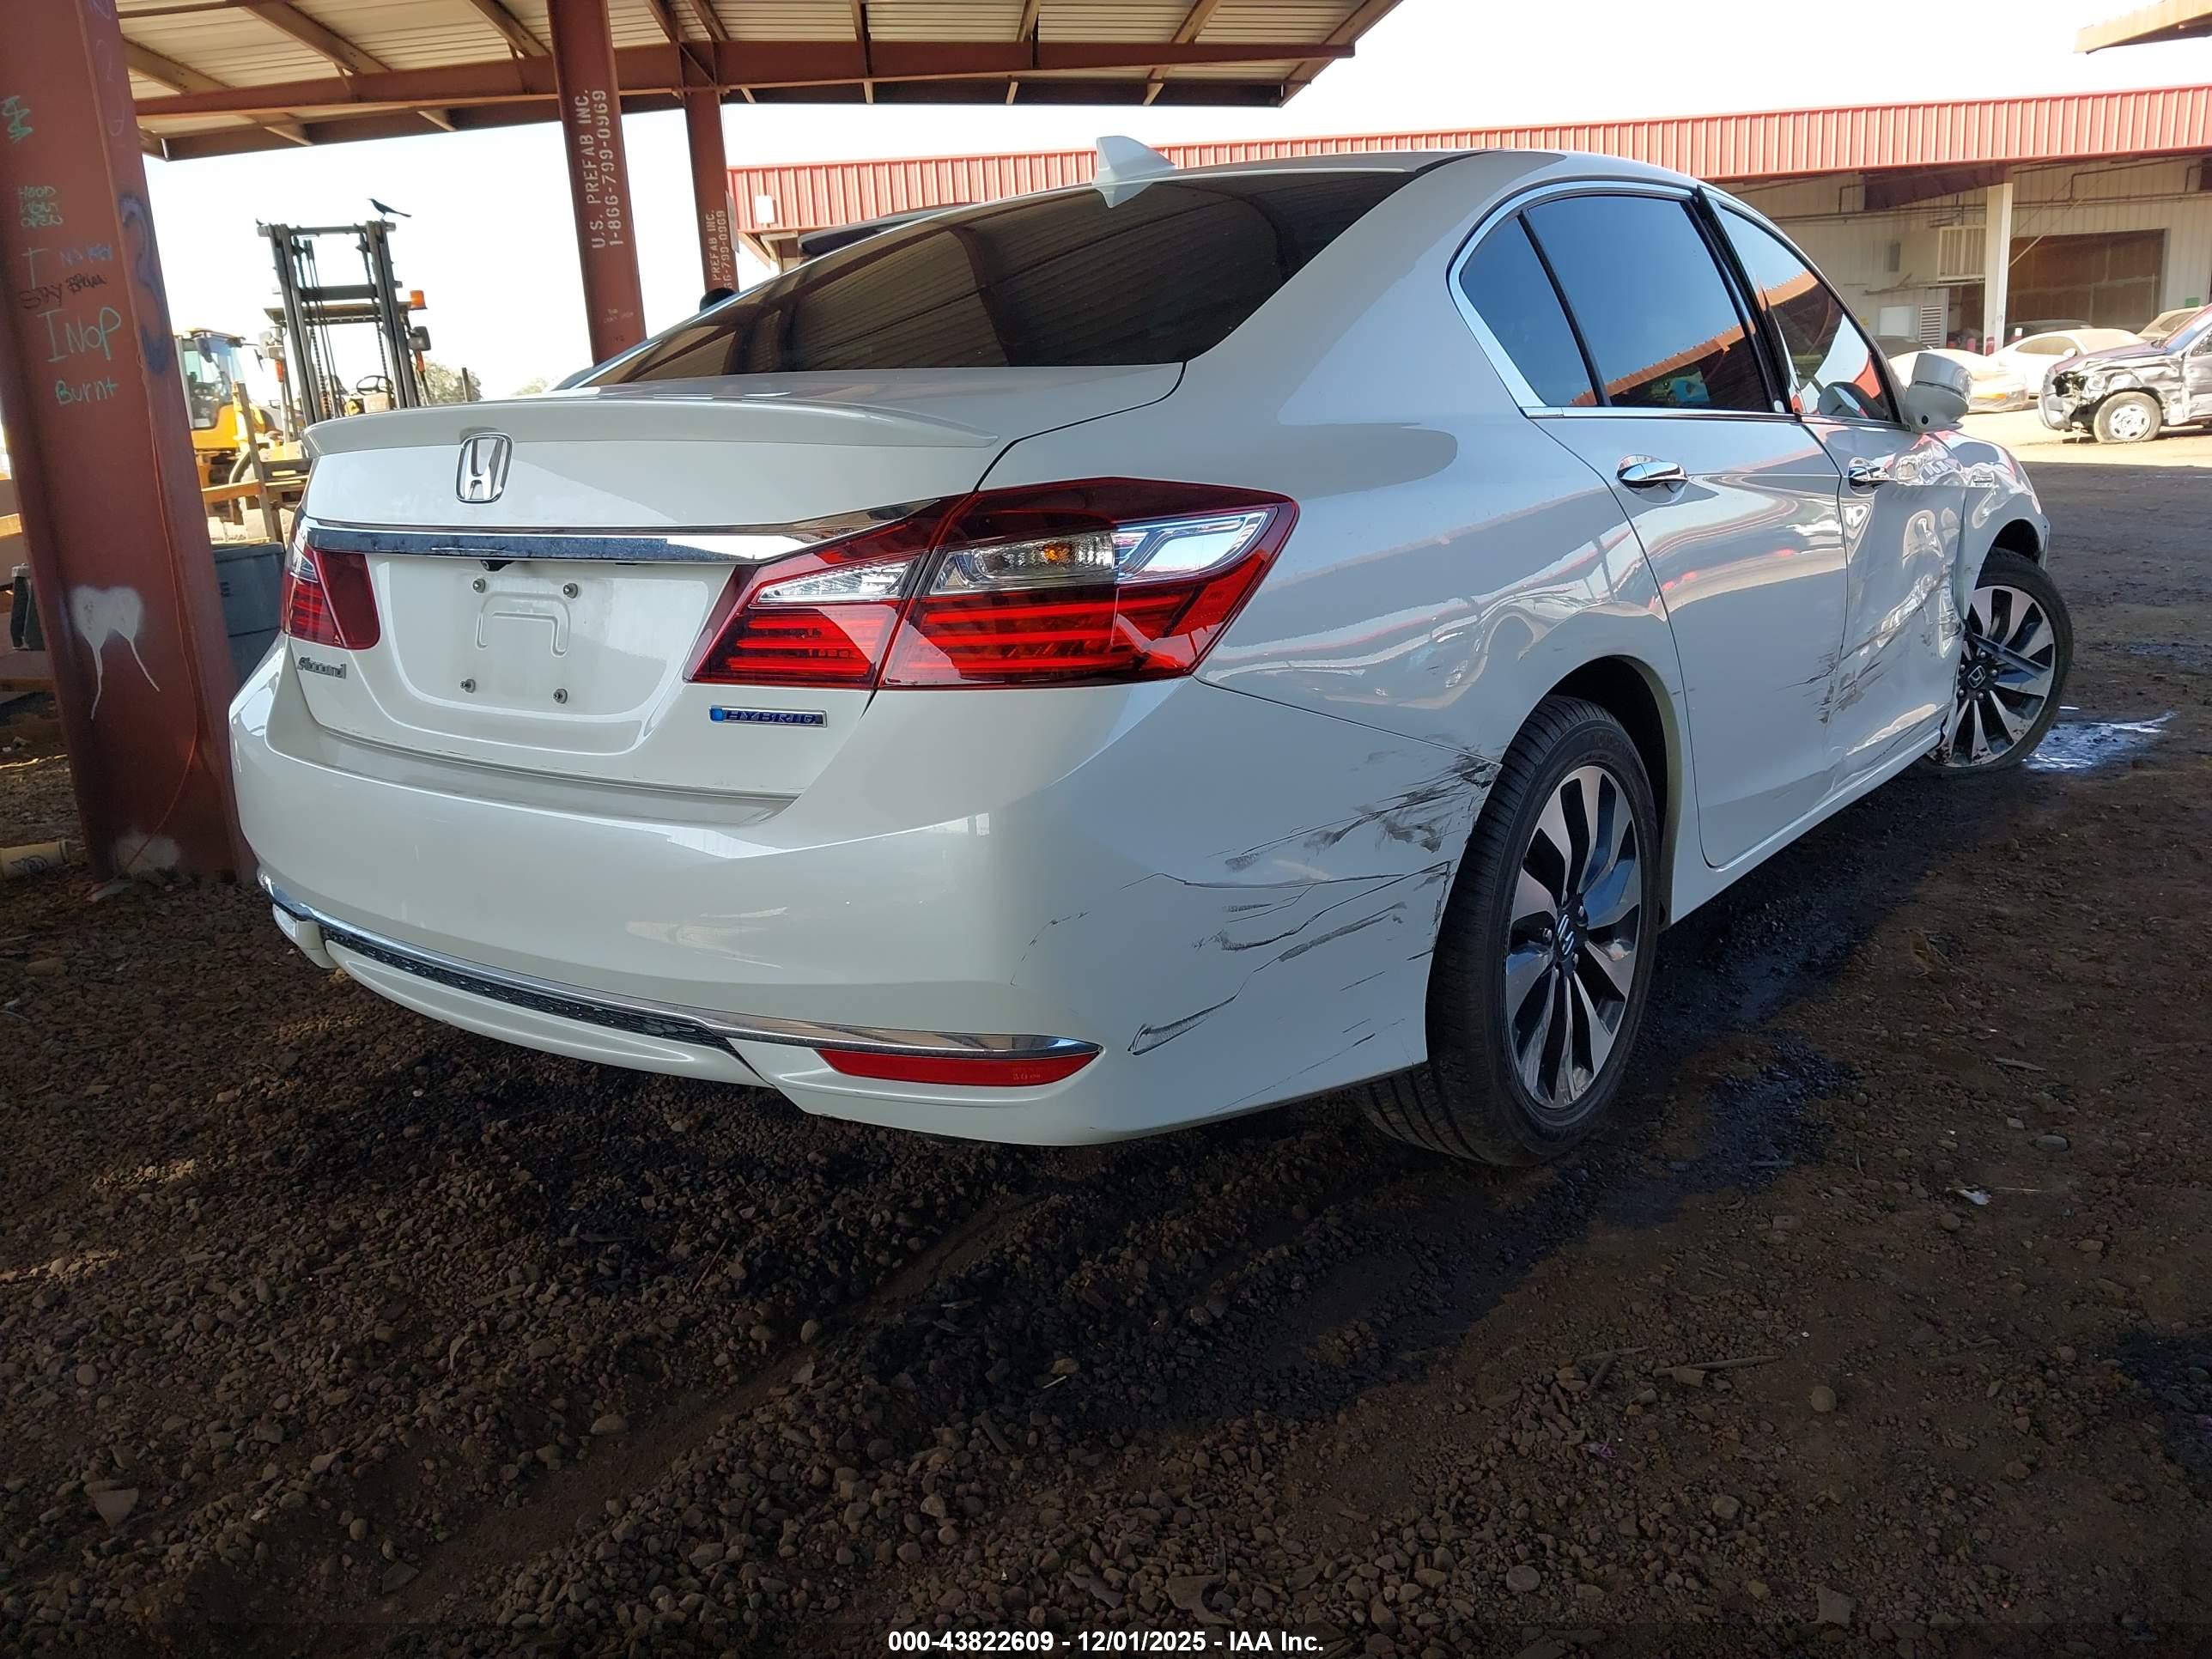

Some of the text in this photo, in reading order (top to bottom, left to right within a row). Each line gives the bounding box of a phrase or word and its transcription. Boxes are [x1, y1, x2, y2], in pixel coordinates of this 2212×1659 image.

[574, 89, 605, 248] U.S. PREFAB INC.
[592, 90, 624, 246] 1-866-799-0969
[708, 236, 722, 282] PREFAB
[55, 377, 118, 406] Burnt
